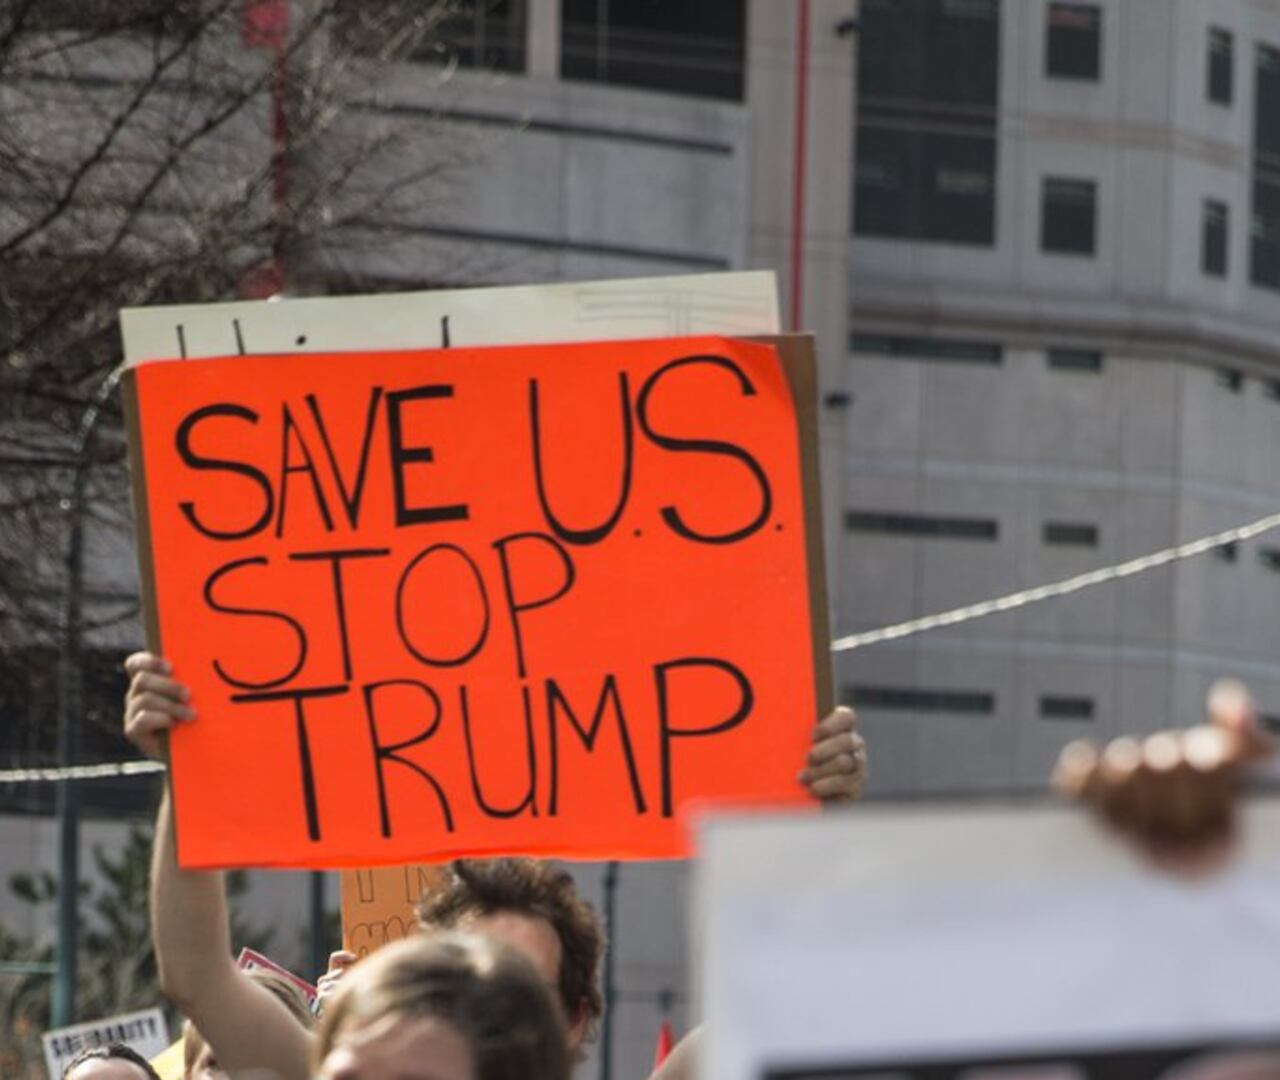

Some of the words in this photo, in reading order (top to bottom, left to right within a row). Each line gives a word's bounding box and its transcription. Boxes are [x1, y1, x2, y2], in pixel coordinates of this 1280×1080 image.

[174, 385, 469, 541] SAVE
[529, 354, 784, 548] U.S.
[203, 532, 577, 690] STOP
[231, 657, 755, 842] TRUMP
